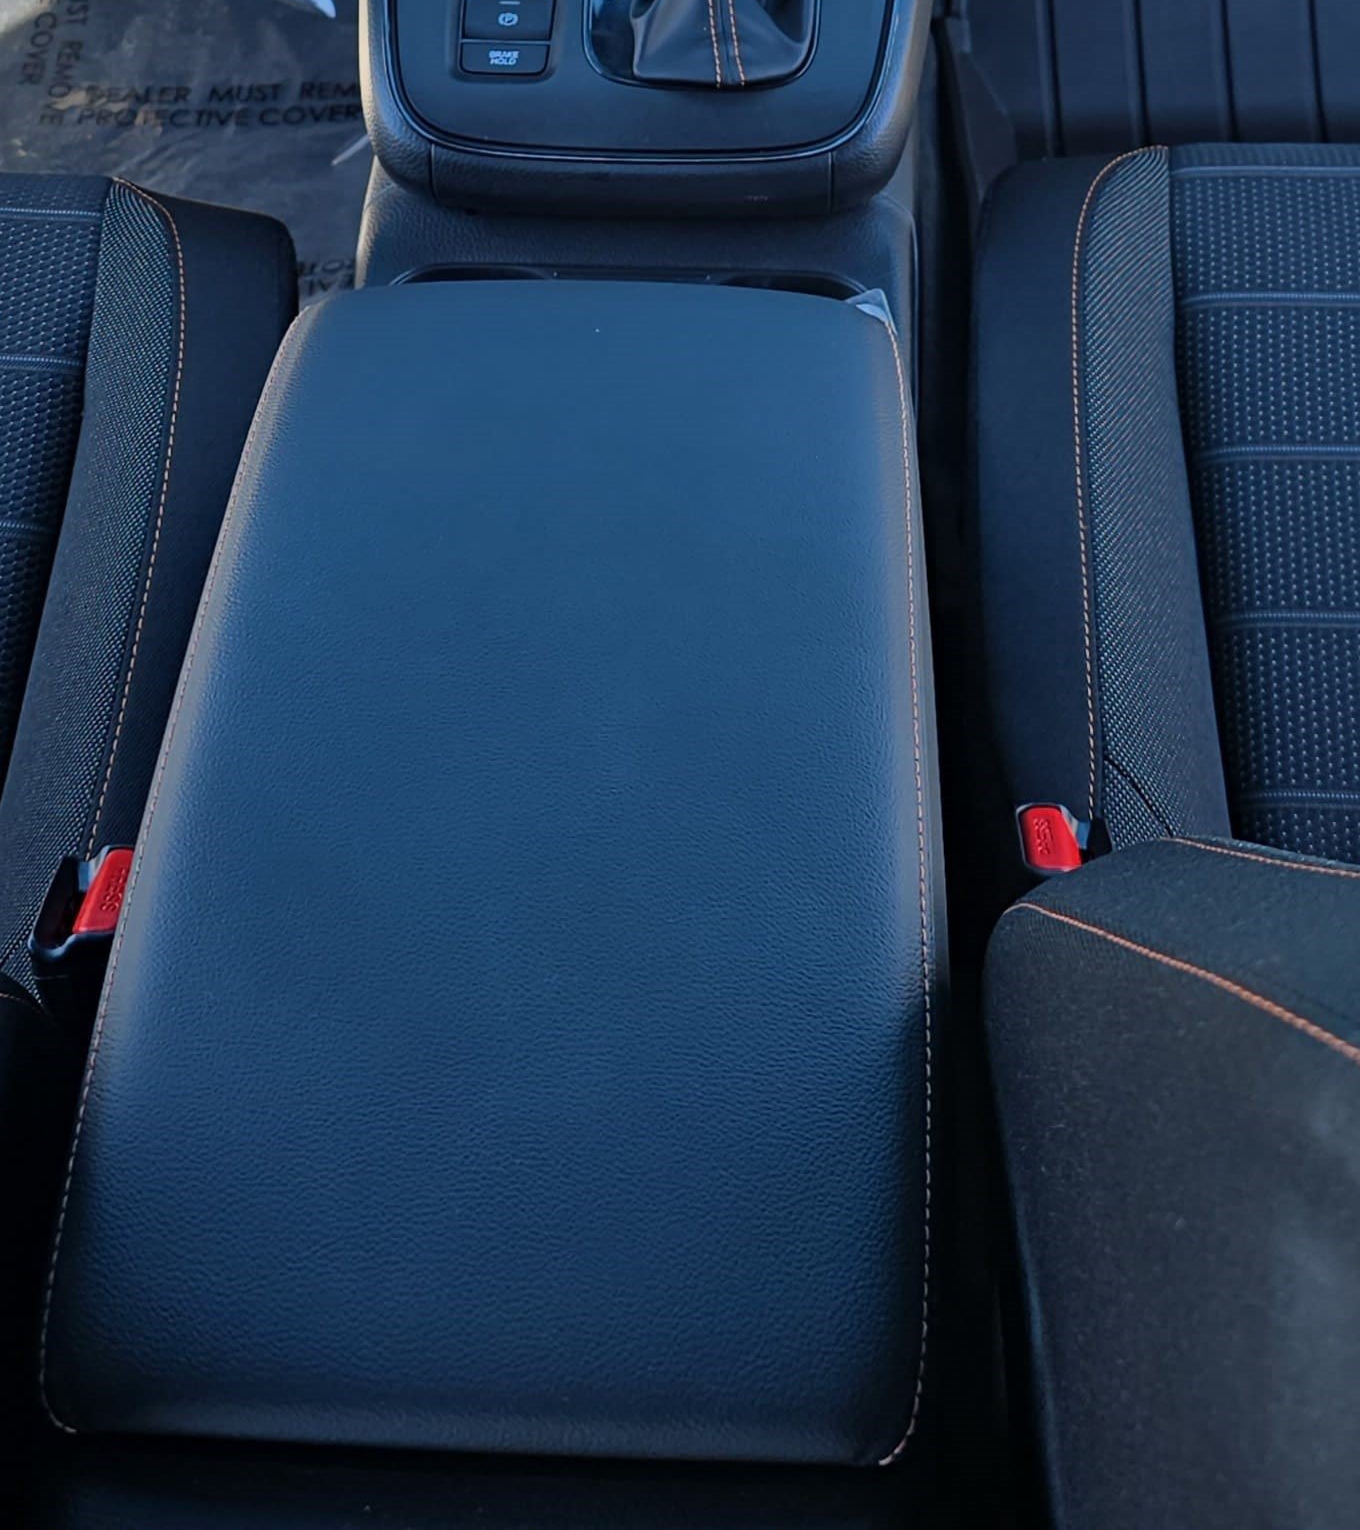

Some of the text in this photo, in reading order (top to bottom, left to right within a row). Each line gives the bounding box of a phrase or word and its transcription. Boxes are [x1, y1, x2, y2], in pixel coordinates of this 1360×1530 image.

[489, 50, 519, 60] BRAKE
[489, 57, 517, 66] HOLD
[208, 82, 283, 102] MUST
[298, 80, 359, 101] REM
